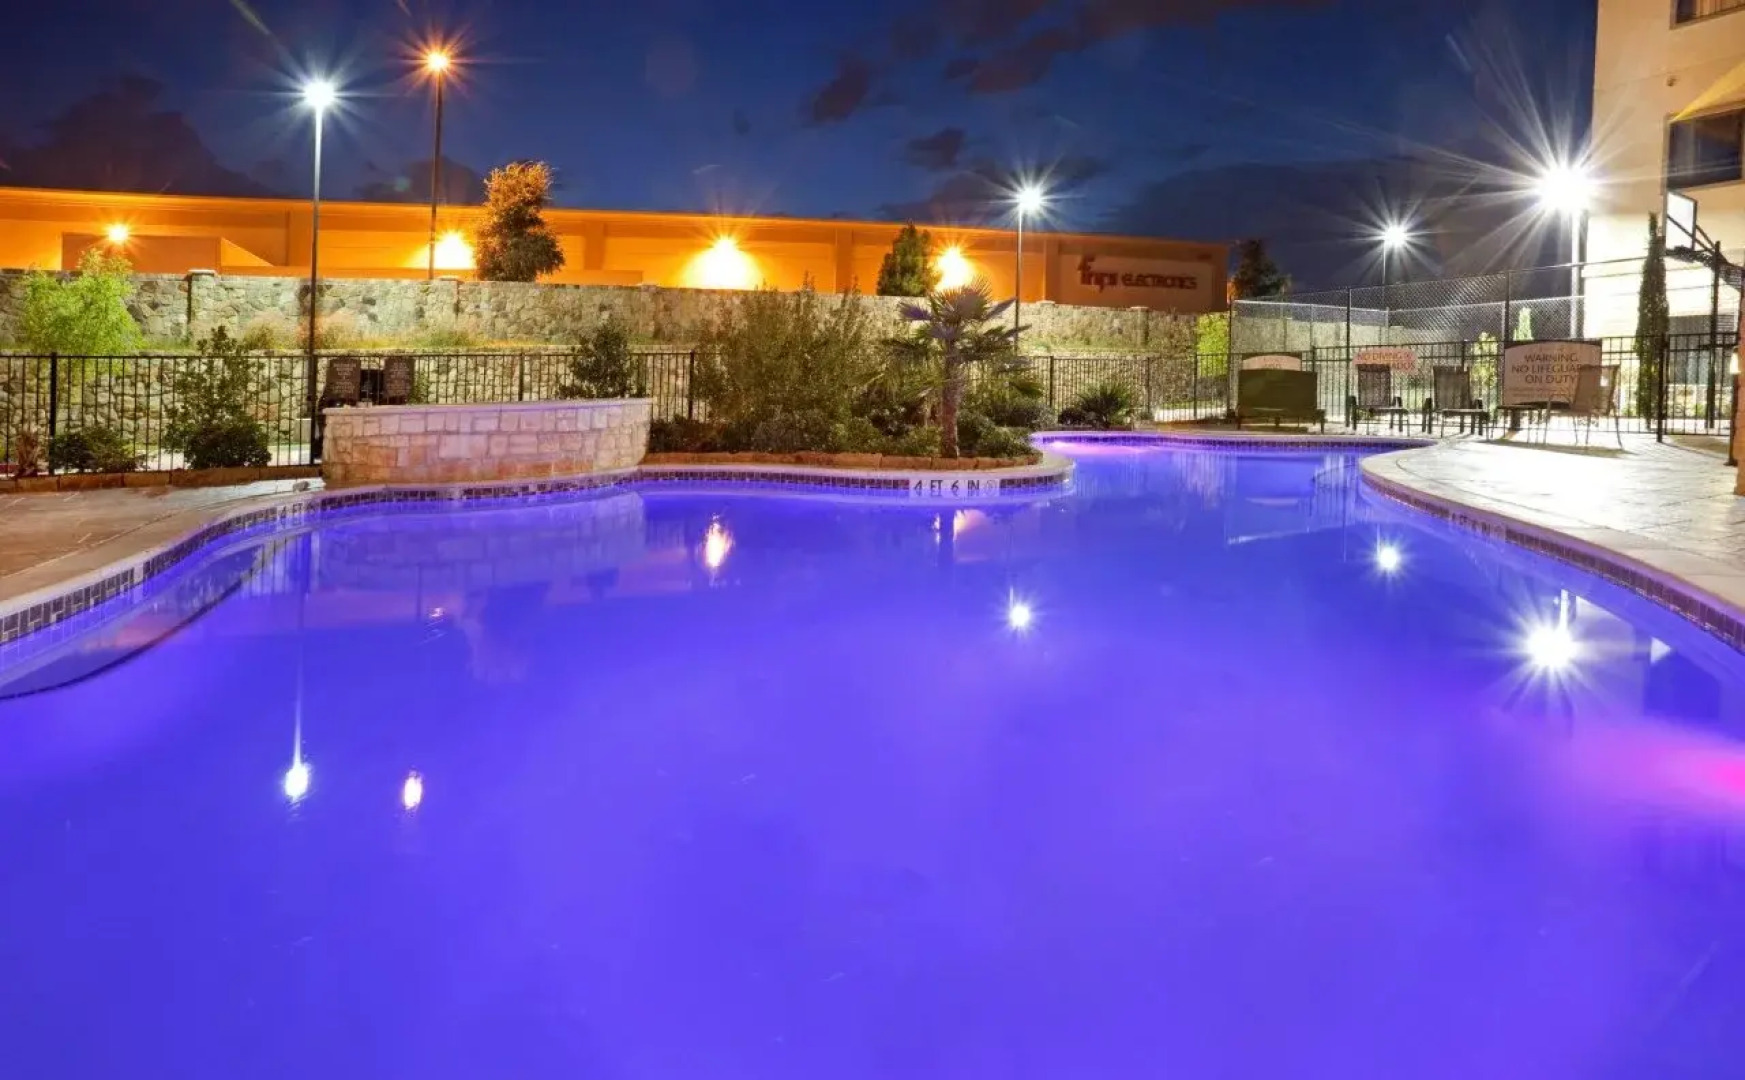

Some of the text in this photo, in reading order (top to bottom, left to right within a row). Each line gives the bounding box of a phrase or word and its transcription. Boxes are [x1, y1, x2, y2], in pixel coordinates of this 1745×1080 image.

[1511, 364, 1529, 373] NO
[1525, 374, 1578, 384] ON DUTY
[951, 479, 960, 490] 6
